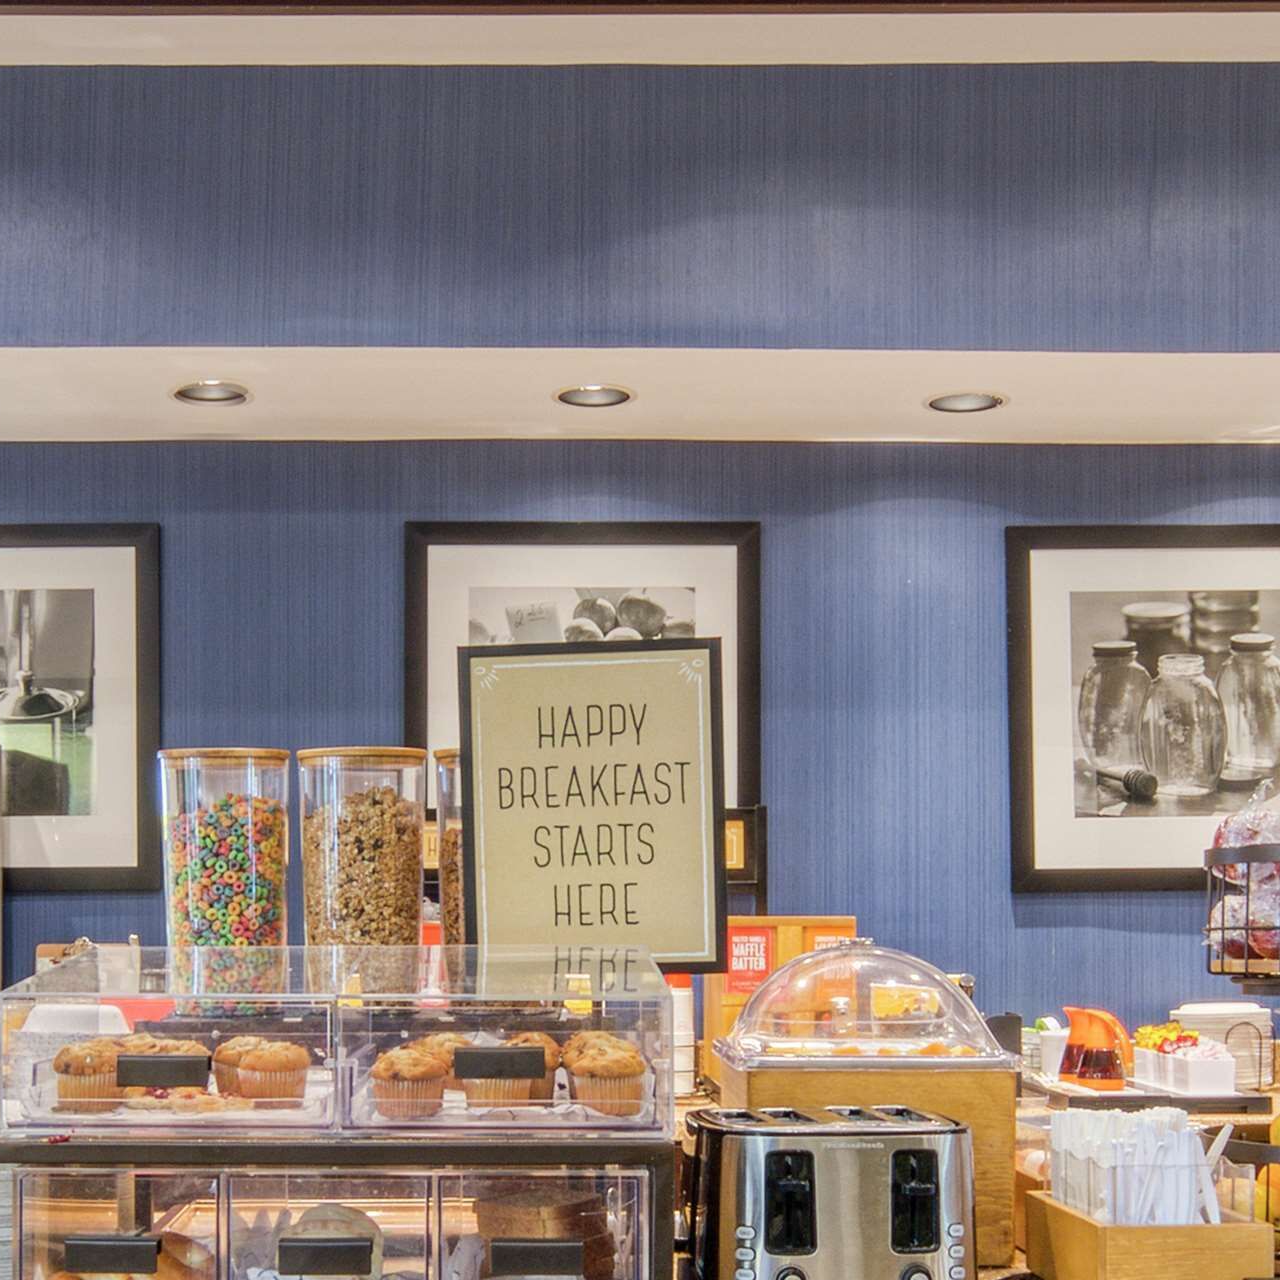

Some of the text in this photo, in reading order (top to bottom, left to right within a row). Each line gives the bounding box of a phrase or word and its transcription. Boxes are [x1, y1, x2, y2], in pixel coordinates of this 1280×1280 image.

[537, 703, 647, 749] HAPPY
[498, 762, 691, 810] BREAKFAST
[533, 822, 655, 868] STARTS
[553, 882, 640, 927] HERE
[731, 942, 766, 957] WAFFLE
[731, 956, 766, 971] BATTER
